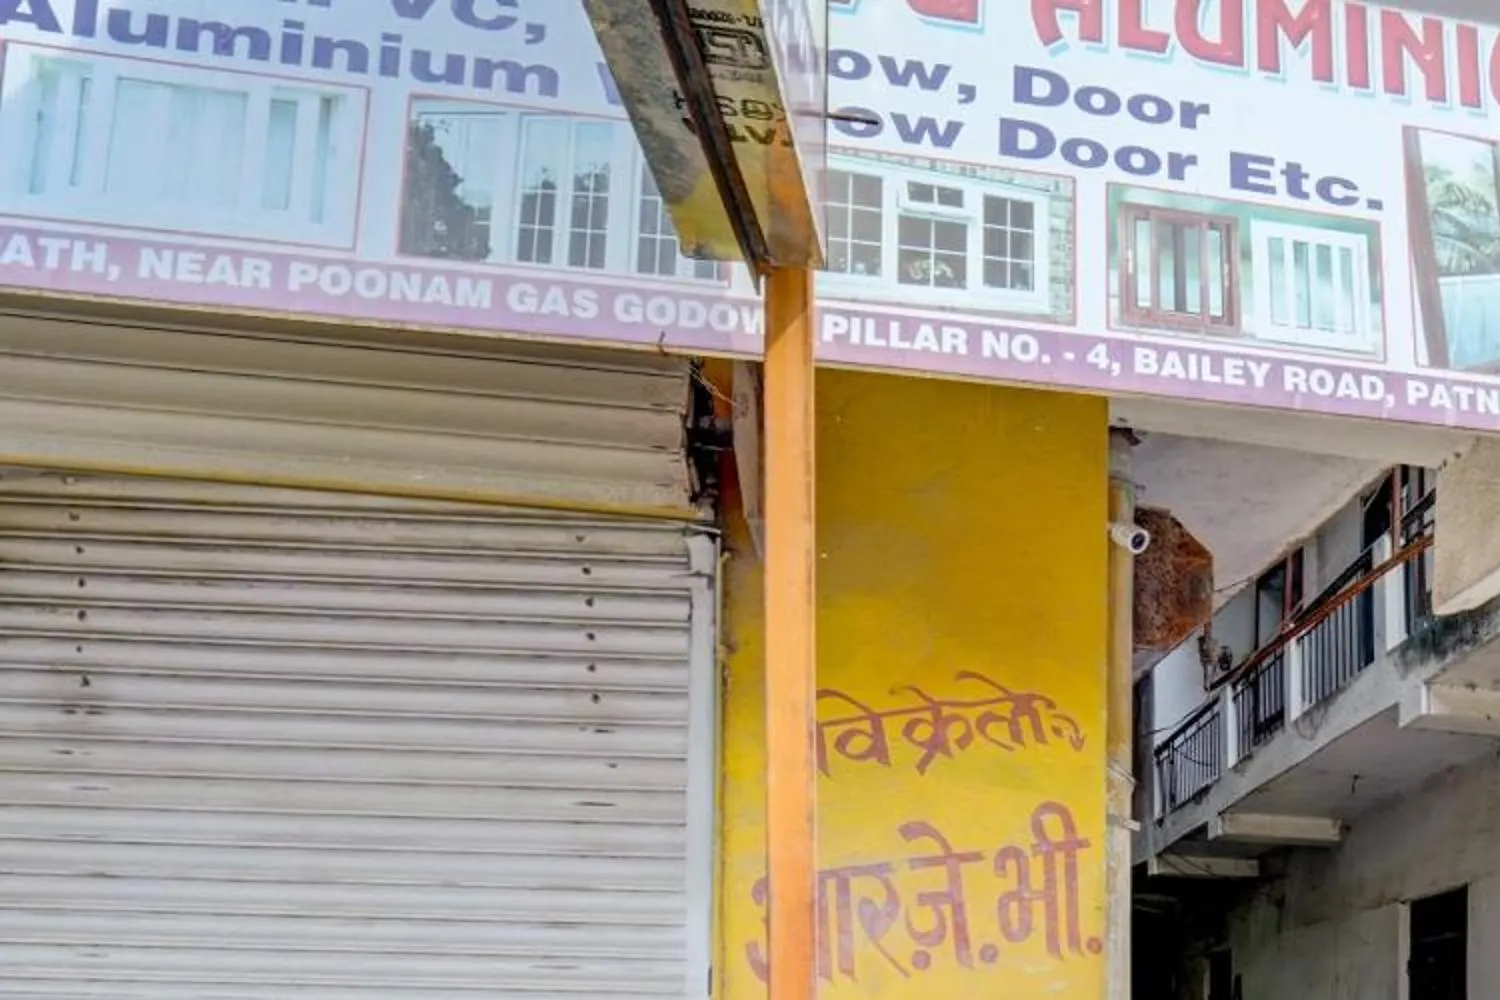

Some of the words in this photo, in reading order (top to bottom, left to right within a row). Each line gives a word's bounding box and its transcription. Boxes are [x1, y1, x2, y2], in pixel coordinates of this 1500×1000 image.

[0, 0, 559, 98] Aluminium
[999, 117, 1198, 181] Door
[1229, 151, 1383, 211] Etc.
[1013, 65, 1210, 129] Door
[138, 247, 271, 290] NEAR
[287, 260, 492, 309] POONAM
[506, 282, 600, 320] GAS
[821, 313, 967, 356] PILLAR
[982, 329, 1050, 365] NO.
[1086, 343, 1121, 377] 4,
[1133, 347, 1271, 388] BAILEY
[1284, 367, 1394, 408] ROAD,
